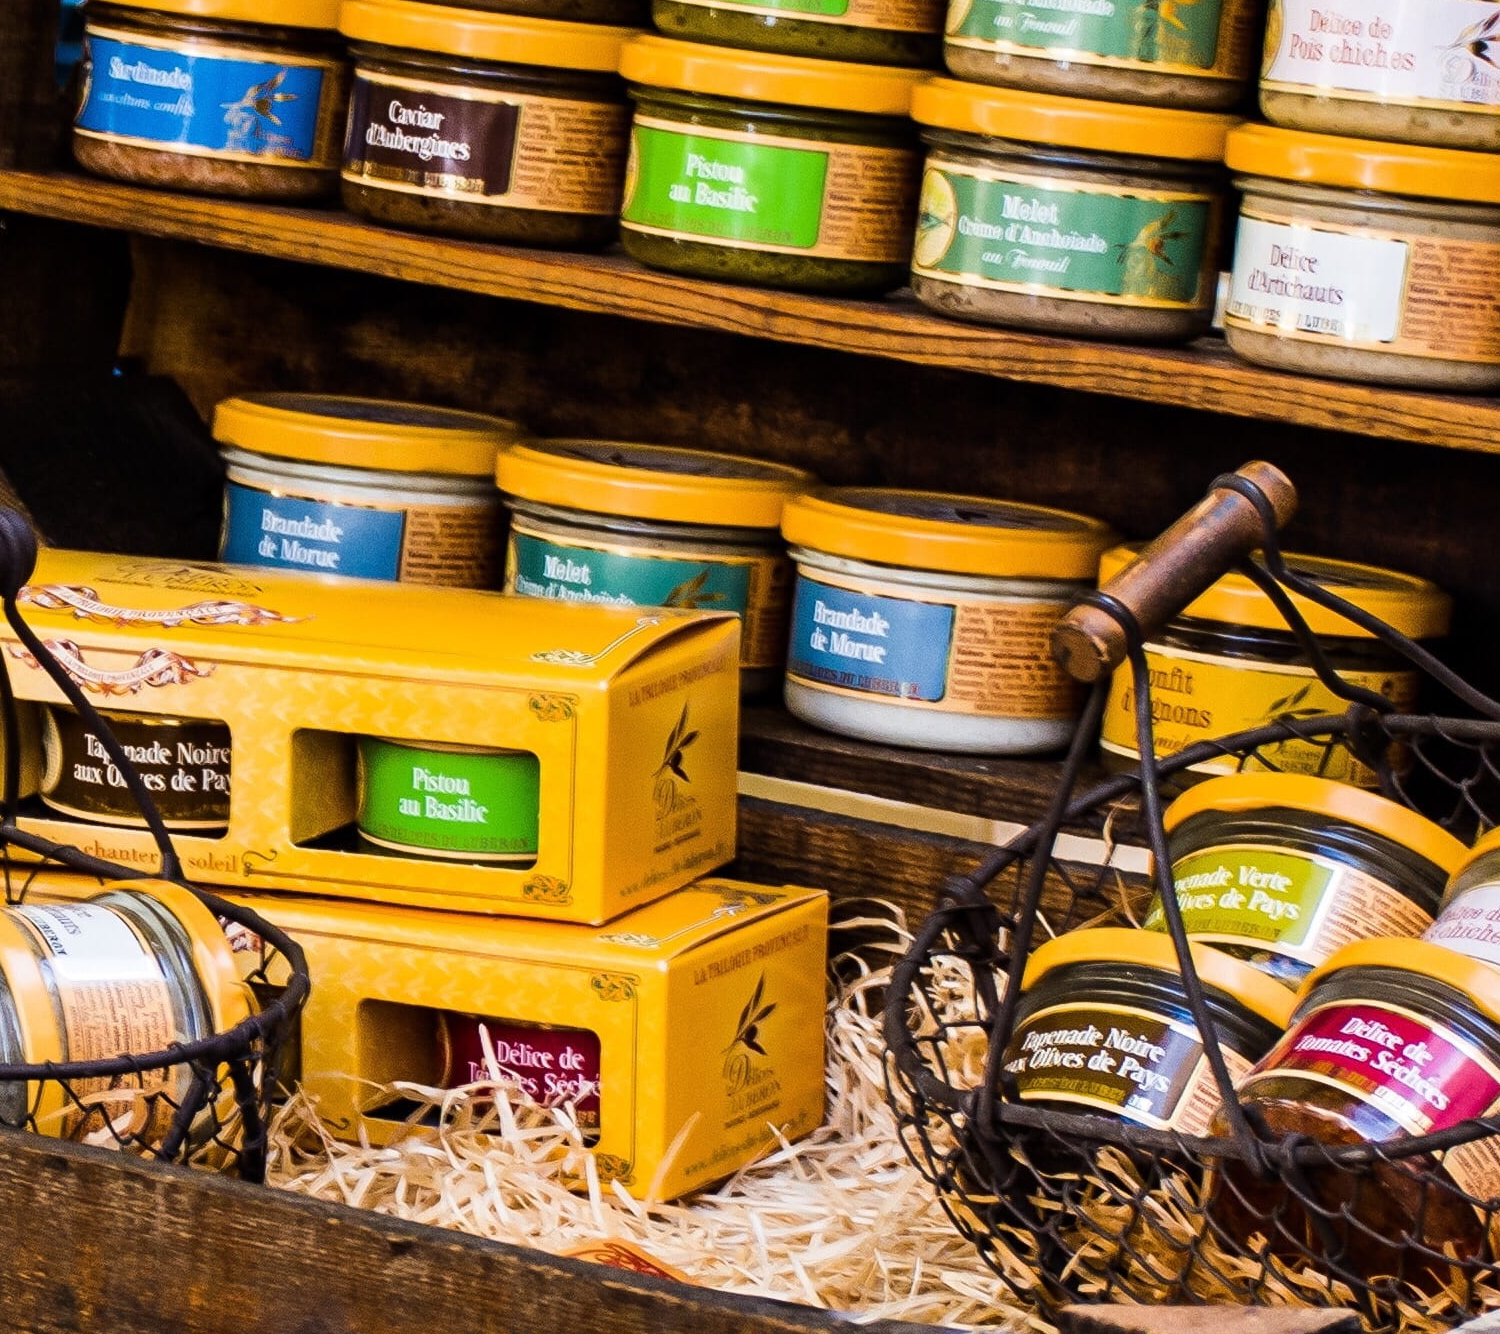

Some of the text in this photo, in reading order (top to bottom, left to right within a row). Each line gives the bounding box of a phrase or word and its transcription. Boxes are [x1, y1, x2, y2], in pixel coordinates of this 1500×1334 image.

[1368, 16, 1392, 39] de
[1289, 34, 1416, 70] Pois chiches
[388, 100, 444, 131] Caviar
[366, 123, 471, 162] d'Aubergines
[686, 154, 743, 185] Pistou
[670, 182, 757, 214] au Basilic
[1001, 194, 1059, 224] Melet
[1269, 244, 1319, 274] Délice
[543, 555, 590, 585] Melet
[813, 600, 889, 637] Brandade
[810, 627, 887, 664] de Morue
[177, 741, 230, 767] Noire
[413, 767, 470, 797] Pistou
[399, 795, 489, 824] au Basilic
[82, 840, 238, 874] chanter soleil
[1103, 1027, 1166, 1063] Noire
[1340, 1016, 1433, 1068] Délice de
[1030, 1043, 1169, 1094] Olives de Pays
[1370, 1049, 1450, 1112] Séchées
